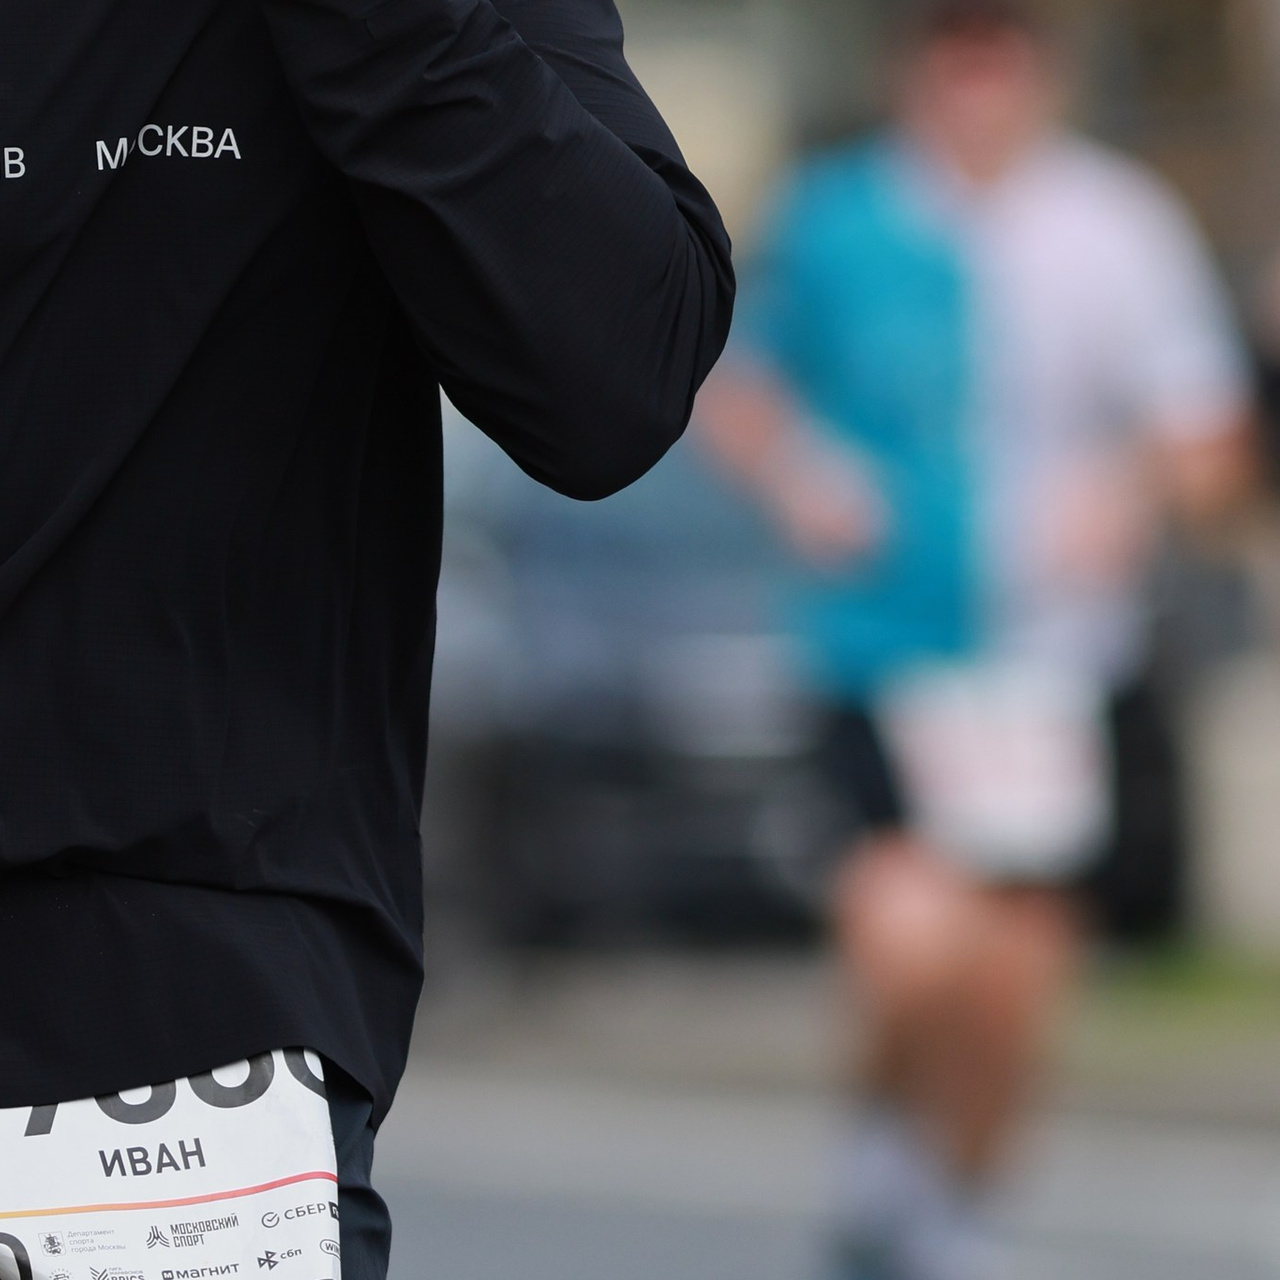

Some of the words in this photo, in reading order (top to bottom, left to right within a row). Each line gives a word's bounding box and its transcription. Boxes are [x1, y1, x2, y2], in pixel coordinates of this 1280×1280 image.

[95, 123, 242, 170] МСКВА
[98, 1137, 206, 1178] ИВАН
[284, 1202, 327, 1220] СБЕР
[170, 1212, 239, 1236] МОСКОВСКИЙ
[173, 1233, 205, 1248] СПОРТ
[280, 1248, 303, 1260] сбп
